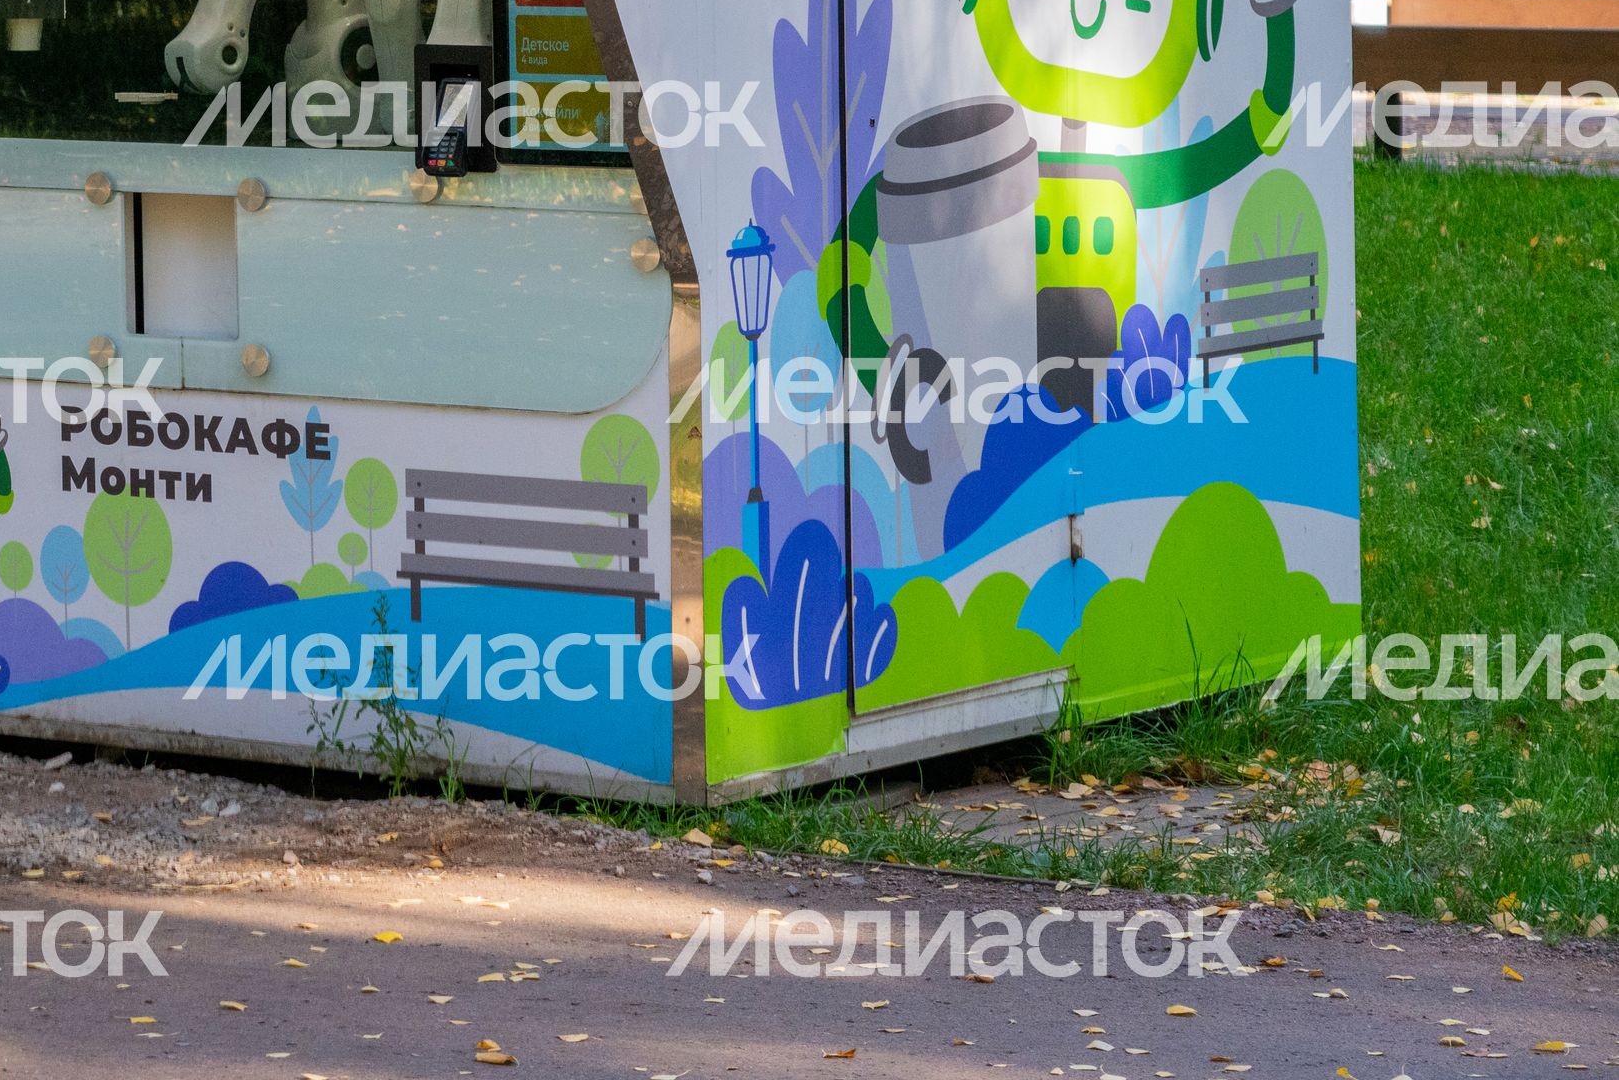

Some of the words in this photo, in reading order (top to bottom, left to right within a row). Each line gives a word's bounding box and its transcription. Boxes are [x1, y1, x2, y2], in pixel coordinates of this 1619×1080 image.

[521, 37, 570, 53] Детское
[521, 55, 527, 65] 4
[528, 56, 549, 66] вида
[523, 104, 580, 121] Коктейли
[60, 404, 332, 462] РОБОКАФЕ
[61, 455, 213, 504] Монти
